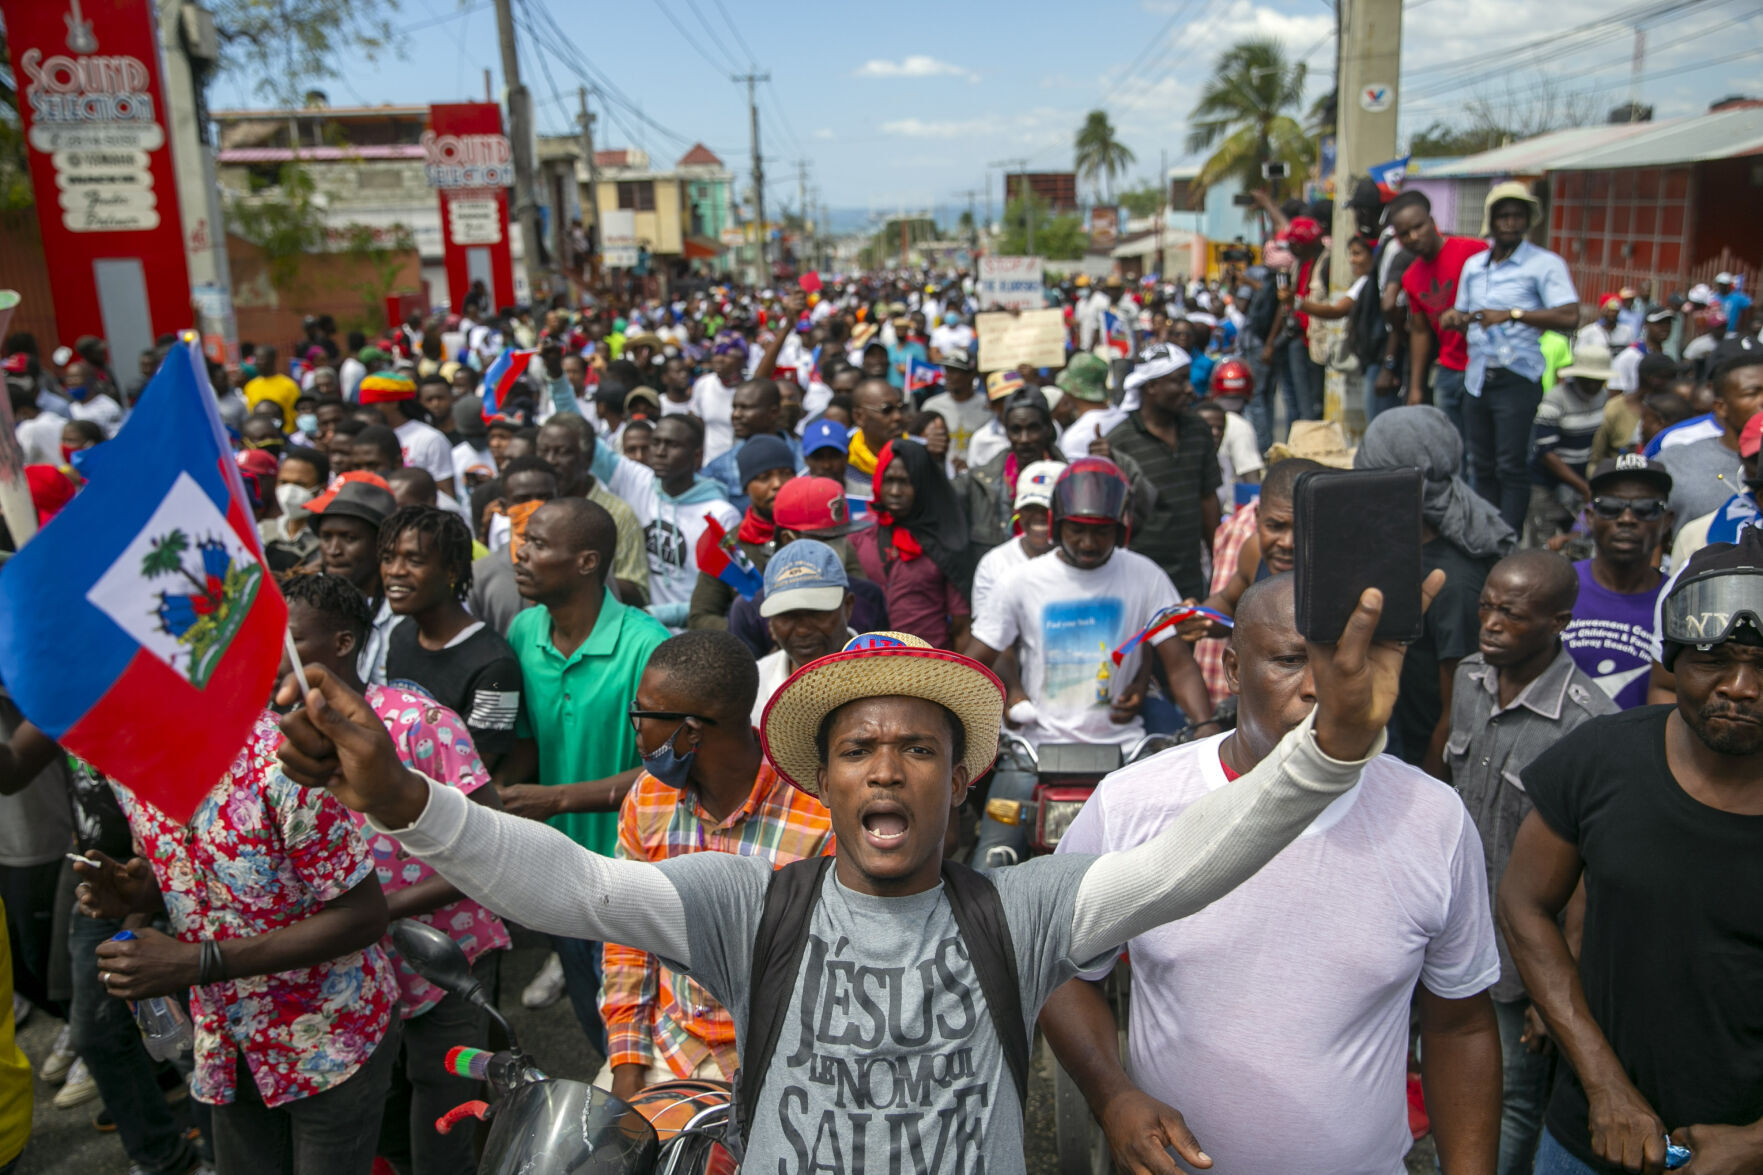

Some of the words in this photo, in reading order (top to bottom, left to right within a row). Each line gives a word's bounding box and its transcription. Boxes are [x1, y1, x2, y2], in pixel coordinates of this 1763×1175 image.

[21, 48, 150, 97] SOUND
[29, 91, 154, 121] SELECTION
[419, 130, 512, 165] SOUND
[424, 161, 516, 188] SELECTION
[1616, 453, 1648, 468] LOS
[787, 934, 976, 1068] JÉSUS
[808, 1052, 837, 1086] LE
[834, 1055, 934, 1110] NOM
[931, 1046, 975, 1089] QUI
[778, 1082, 989, 1175] SAUVE
